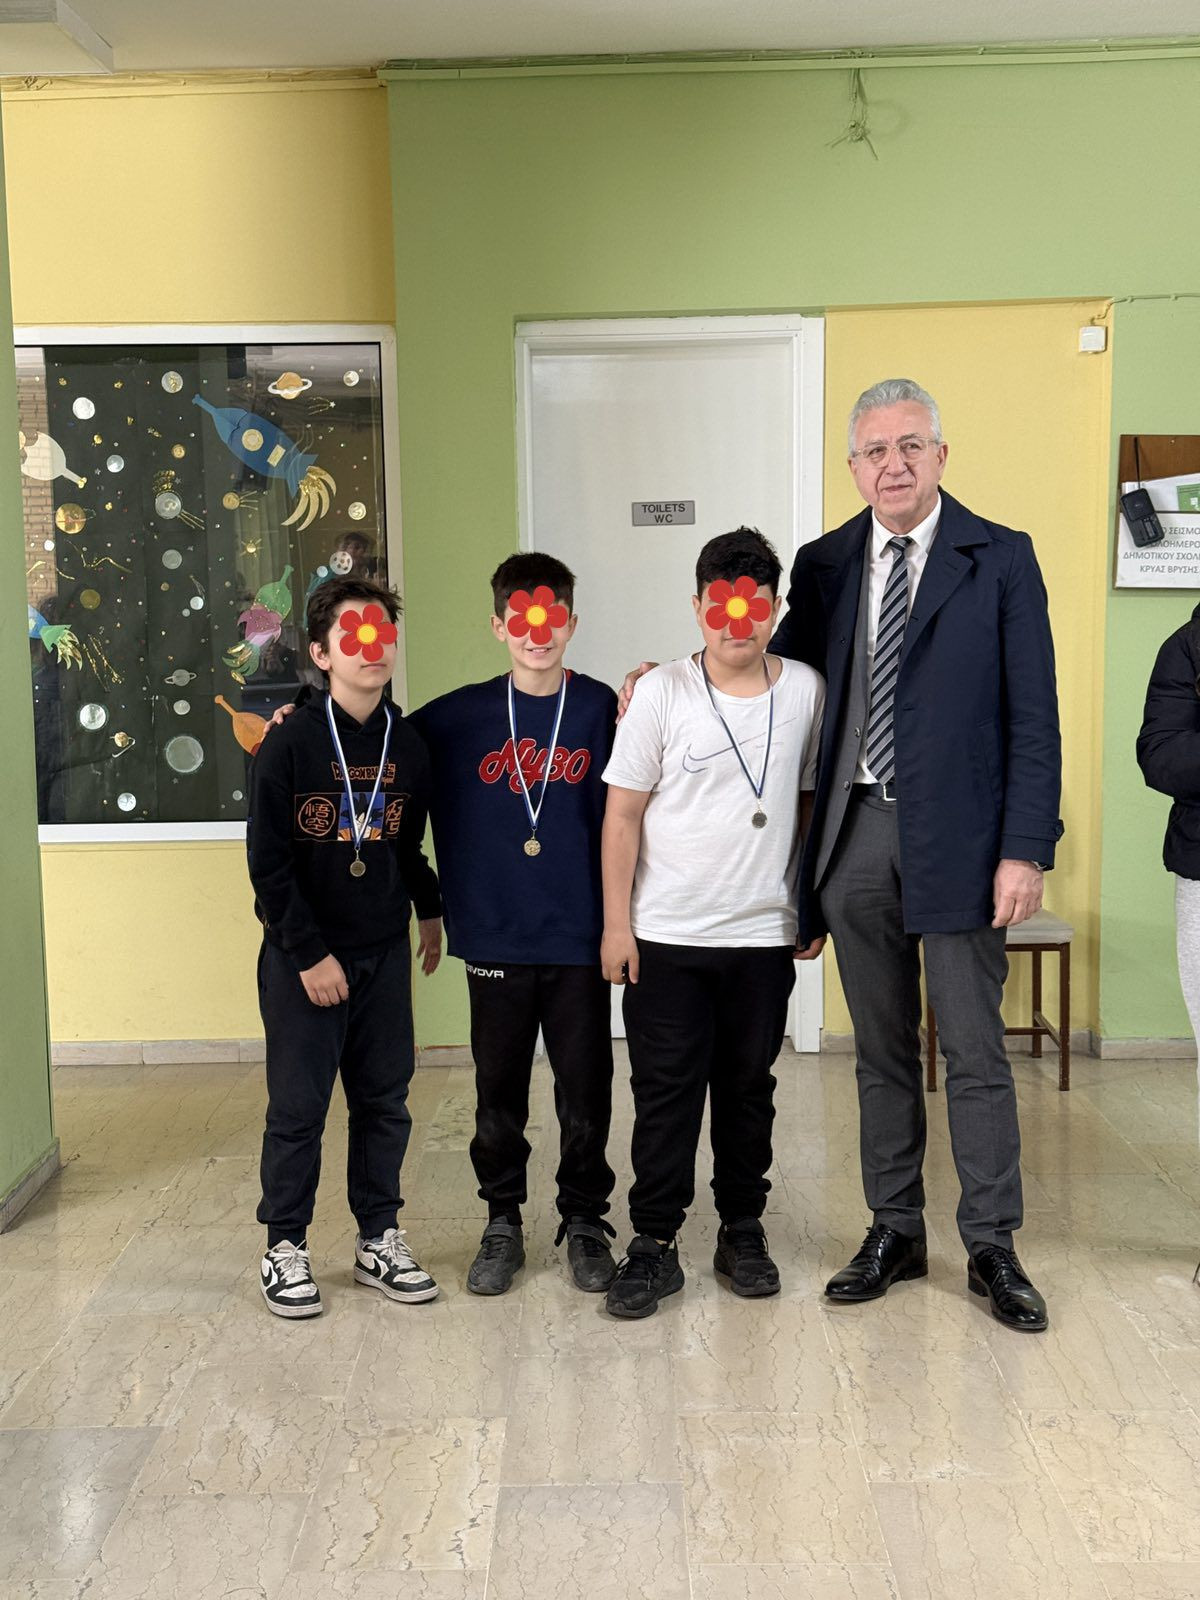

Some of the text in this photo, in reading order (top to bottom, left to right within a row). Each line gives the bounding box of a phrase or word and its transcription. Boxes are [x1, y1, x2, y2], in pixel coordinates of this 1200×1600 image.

[641, 503, 686, 513] TOILETS
[654, 514, 673, 523] WC
[1123, 552, 1200, 561] ΔΗΜΟΤΙΚΟΥ ΣΧΟΛ
[1140, 565, 1199, 574] ΚΡΥΑΣ ΒΡΥΣΗΣ
